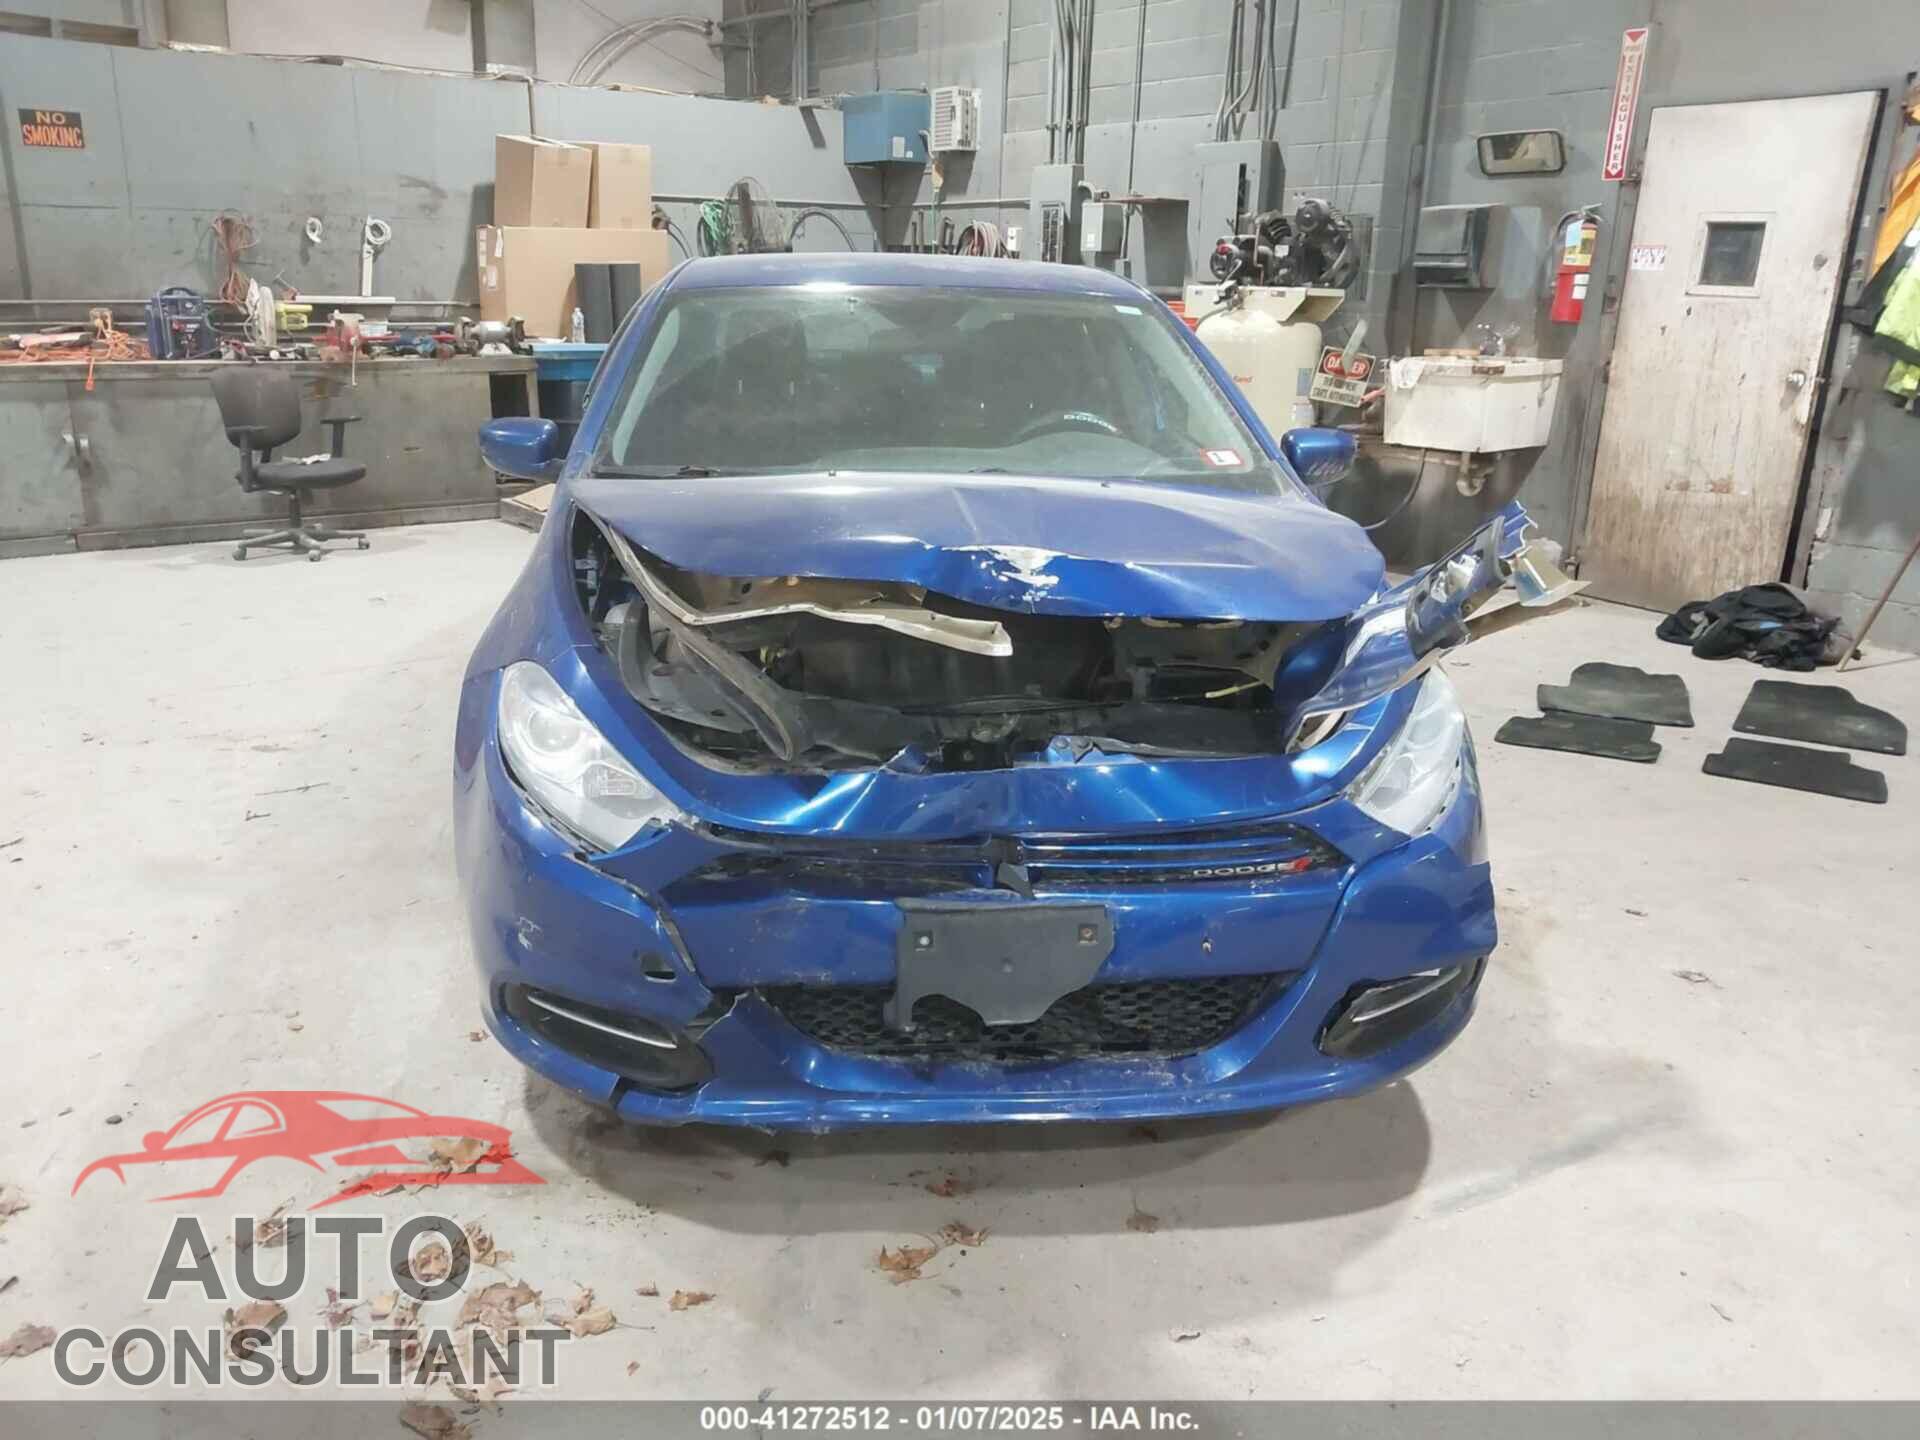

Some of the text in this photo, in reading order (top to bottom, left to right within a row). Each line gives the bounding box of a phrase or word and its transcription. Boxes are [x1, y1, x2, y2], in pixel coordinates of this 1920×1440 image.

[35, 111, 65, 125] NO
[23, 124, 82, 147] SMOKING
[1327, 355, 1366, 375] DAER
[1193, 862, 1292, 876] DODGE
